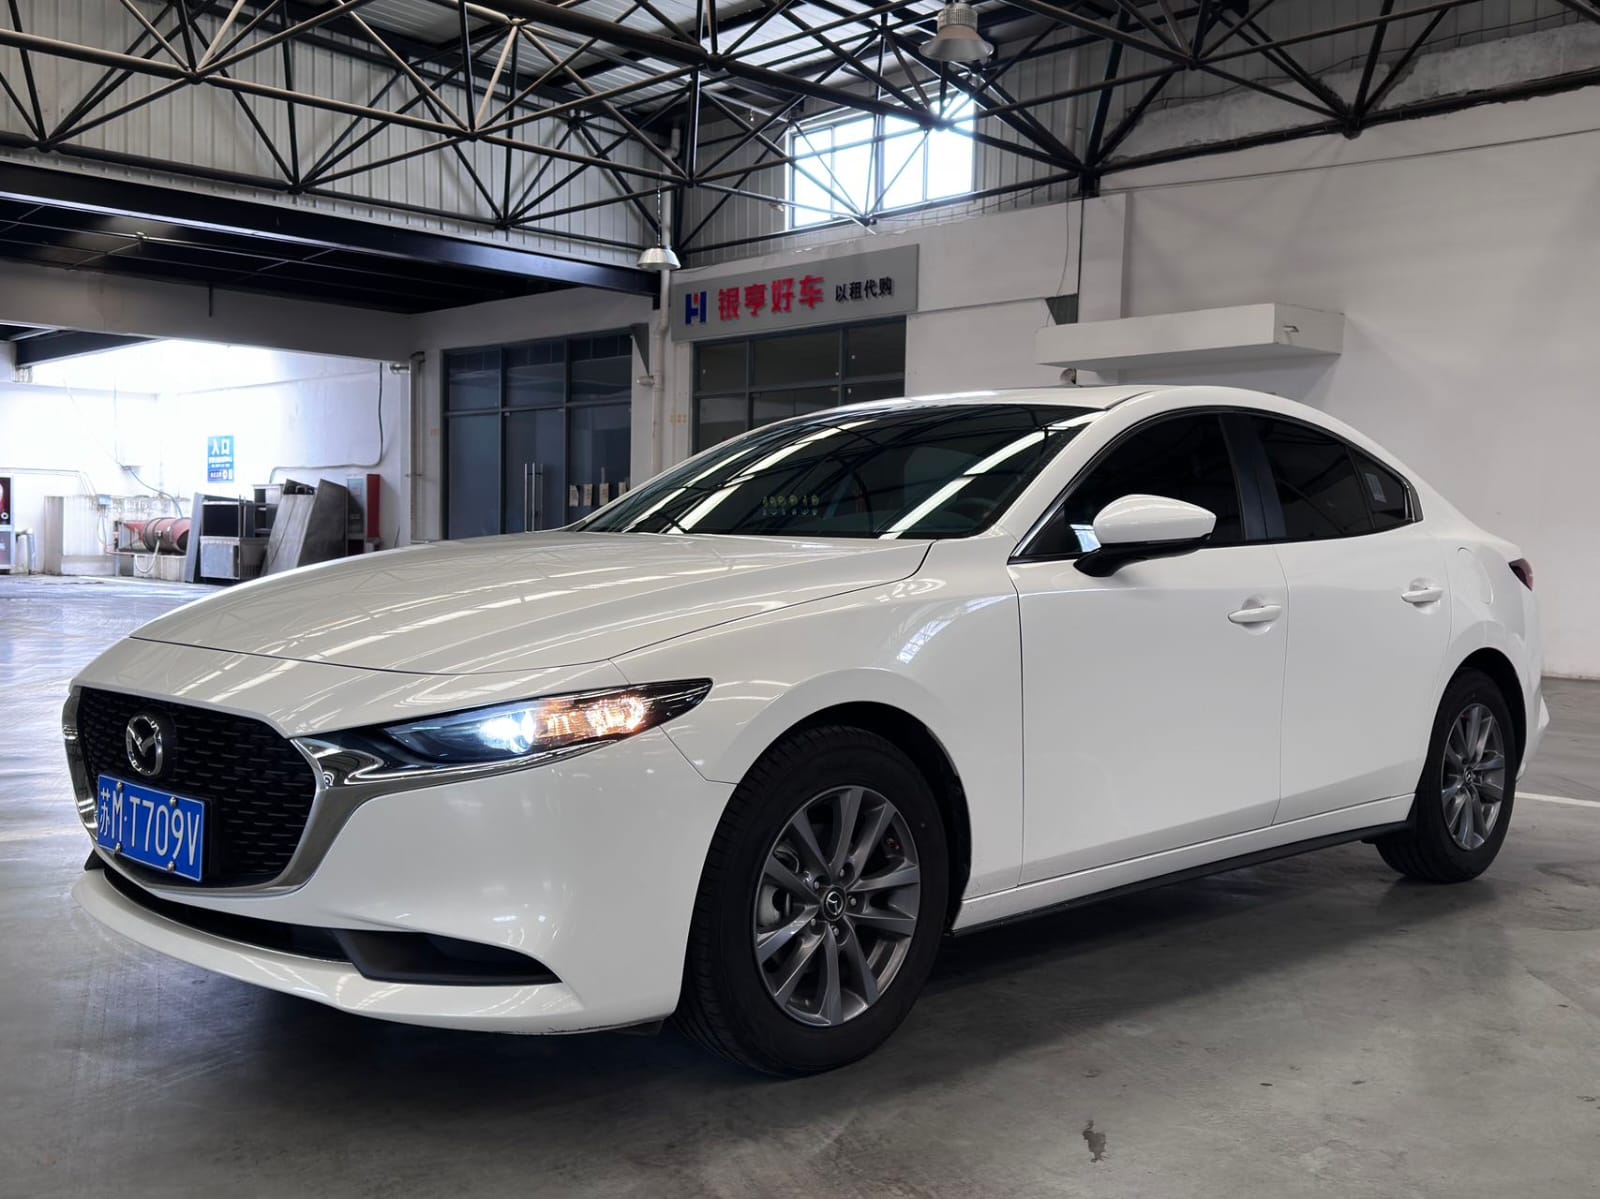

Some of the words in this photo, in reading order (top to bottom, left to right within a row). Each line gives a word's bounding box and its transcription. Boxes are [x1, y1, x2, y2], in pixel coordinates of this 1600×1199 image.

[718, 275, 826, 321] 银亨好车
[834, 277, 893, 303] 以租代购
[211, 438, 230, 455] 入口
